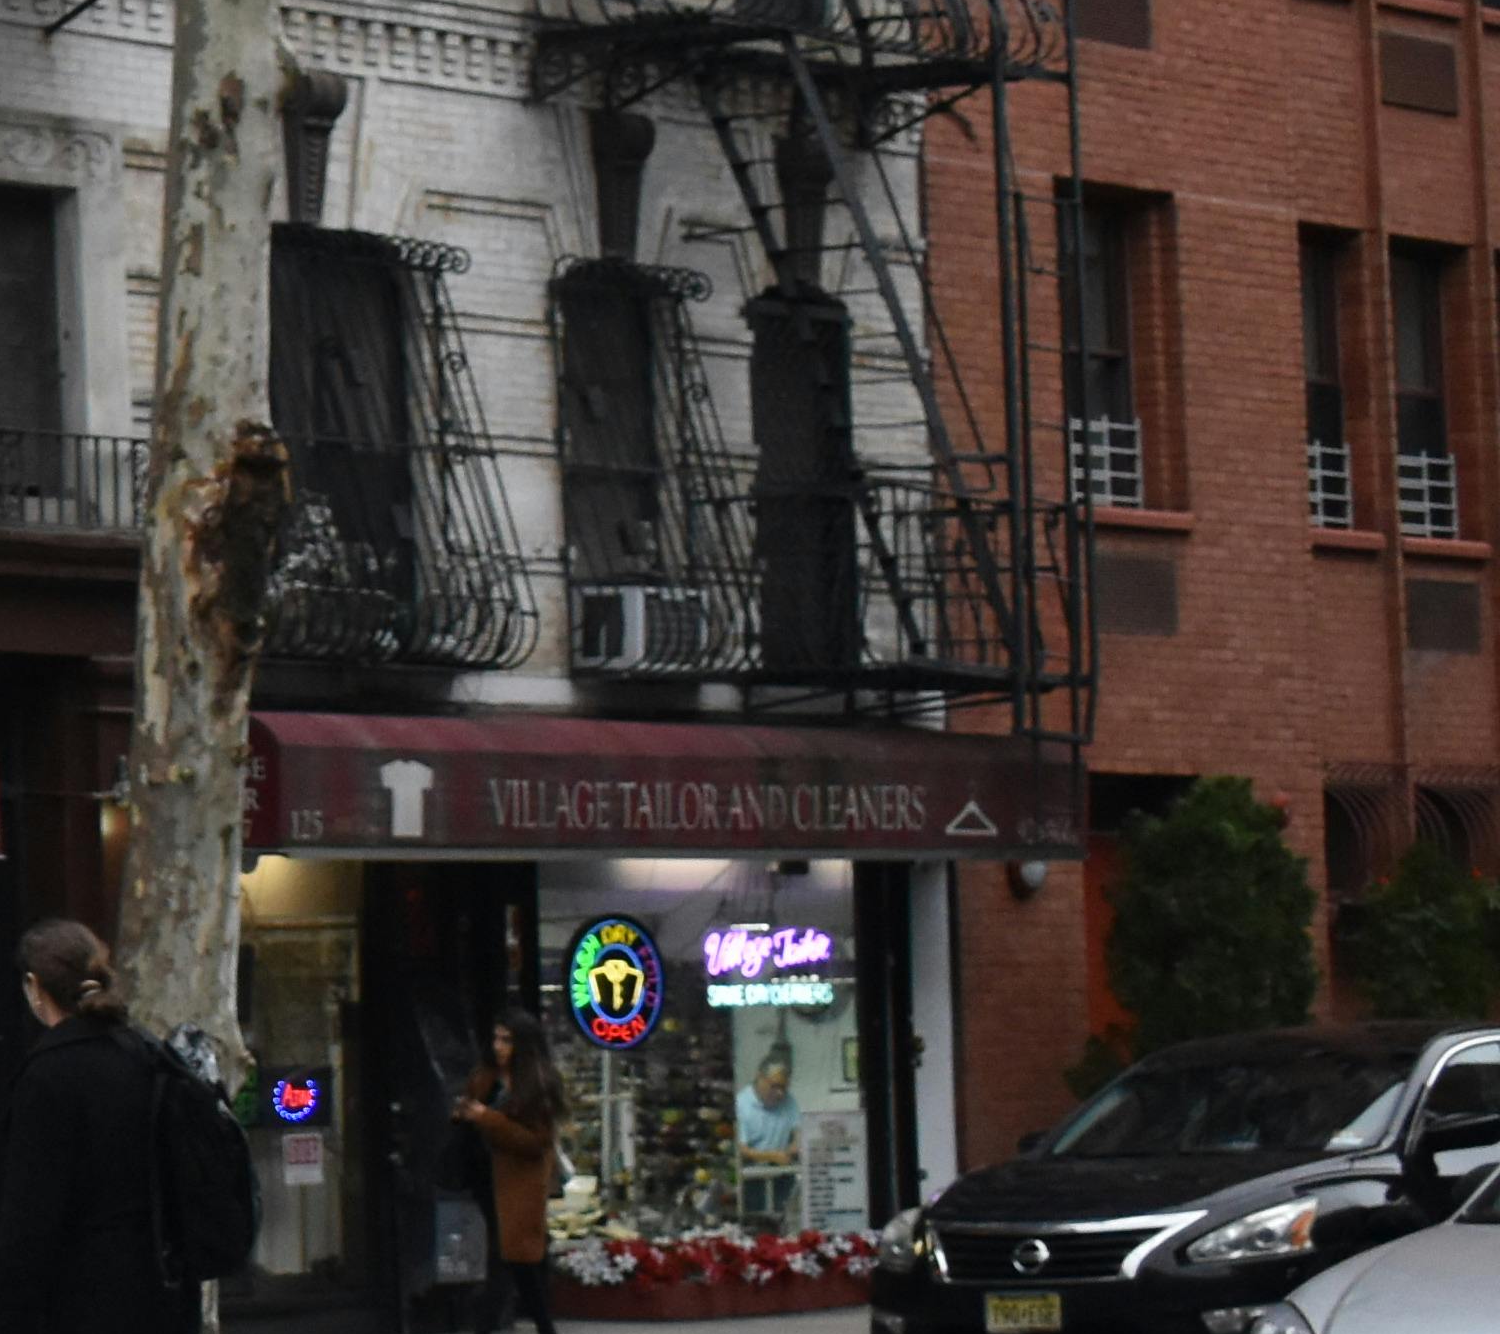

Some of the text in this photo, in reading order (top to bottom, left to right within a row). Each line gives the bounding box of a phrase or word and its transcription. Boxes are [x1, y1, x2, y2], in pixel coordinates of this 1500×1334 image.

[489, 778, 610, 830] VILLAGE
[617, 781, 720, 831] TAILOR
[728, 782, 784, 830] AND
[792, 783, 927, 833] CLEANERS
[592, 1015, 647, 1043] OPEN
